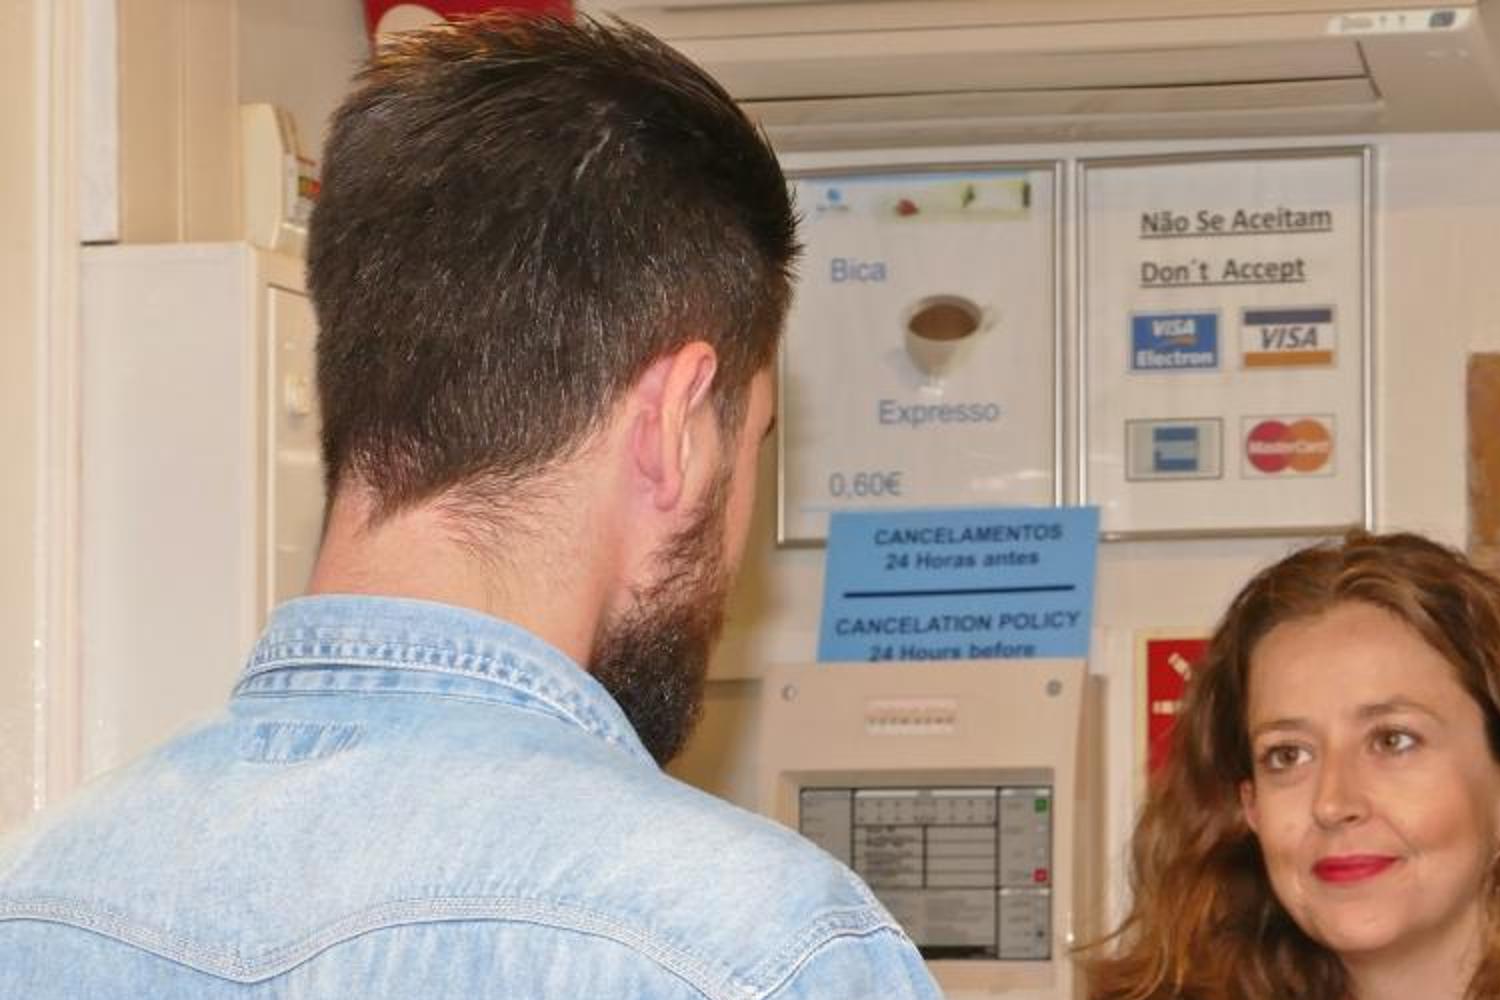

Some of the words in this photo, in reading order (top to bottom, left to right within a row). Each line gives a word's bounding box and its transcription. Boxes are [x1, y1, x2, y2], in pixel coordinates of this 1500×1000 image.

[1140, 211, 1190, 233] Não
[1196, 210, 1225, 231] Se
[1231, 205, 1333, 229] Aceitam
[831, 257, 887, 283] Bica
[1222, 258, 1305, 283] Accept
[1152, 319, 1197, 337] VISA
[1261, 327, 1318, 350] VISA
[1135, 350, 1214, 368] Electron
[879, 399, 1000, 428] Expresso
[873, 522, 1064, 546] CANCELAMENTOS
[884, 553, 909, 571] 24
[915, 552, 977, 570] Horas
[982, 549, 1040, 567] antes
[835, 614, 993, 637] CANCELATION
[998, 609, 1082, 632] POLICY
[868, 645, 895, 662] 24
[899, 643, 962, 660] Hours
[968, 640, 1037, 659] before
